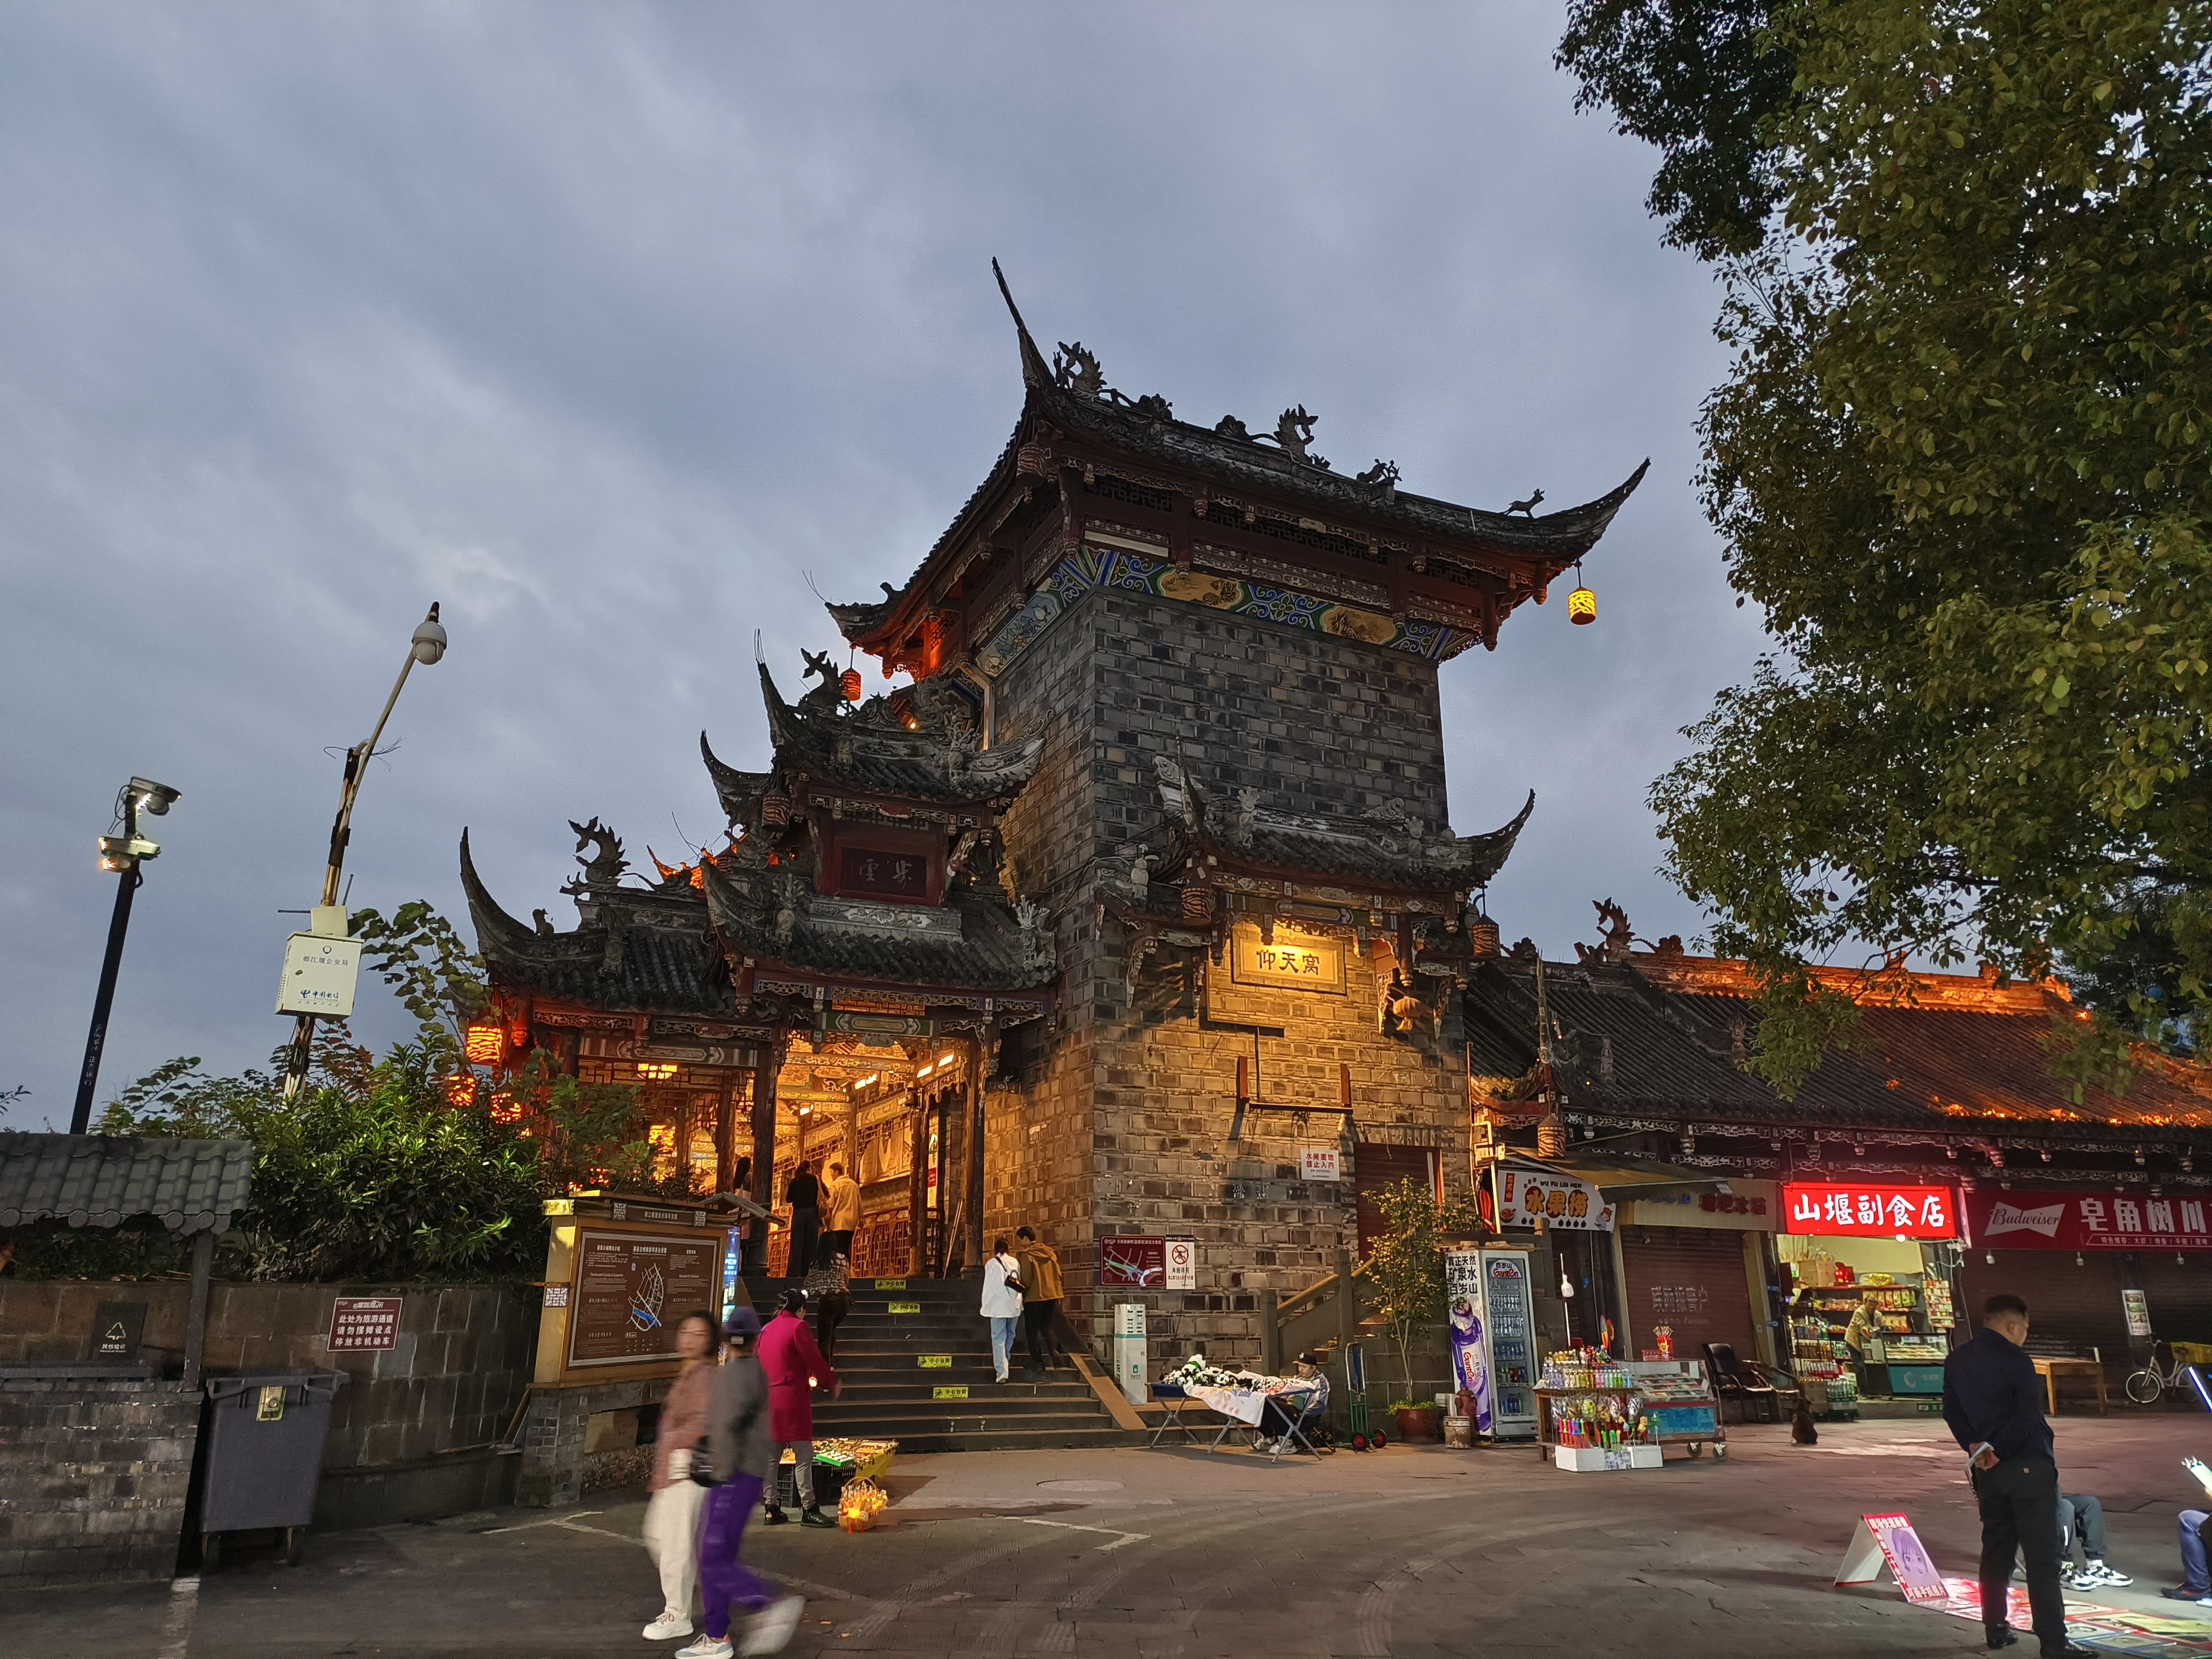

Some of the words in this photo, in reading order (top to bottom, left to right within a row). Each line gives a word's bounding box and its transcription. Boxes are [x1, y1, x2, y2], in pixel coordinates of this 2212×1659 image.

[303, 956, 348, 966] 都江堰公安局
[1256, 948, 1320, 975] 仰天窝
[1306, 1161, 1334, 1169] 禁止入内
[1525, 1190, 1589, 1217] 水果捞
[1794, 1193, 1945, 1227] 山堰副食店
[2080, 1198, 2212, 1233] 皂角树川
[1989, 1209, 2059, 1225] Budweiser
[1448, 1255, 1476, 1266] 真正天然
[1448, 1266, 1477, 1281] 矿泉水
[1449, 1283, 1478, 1294] 百岁山
[338, 1314, 394, 1324] 此处为旅游通道
[336, 1325, 392, 1335] 请勿摆摊设点
[335, 1337, 390, 1346] 停放非机动车
